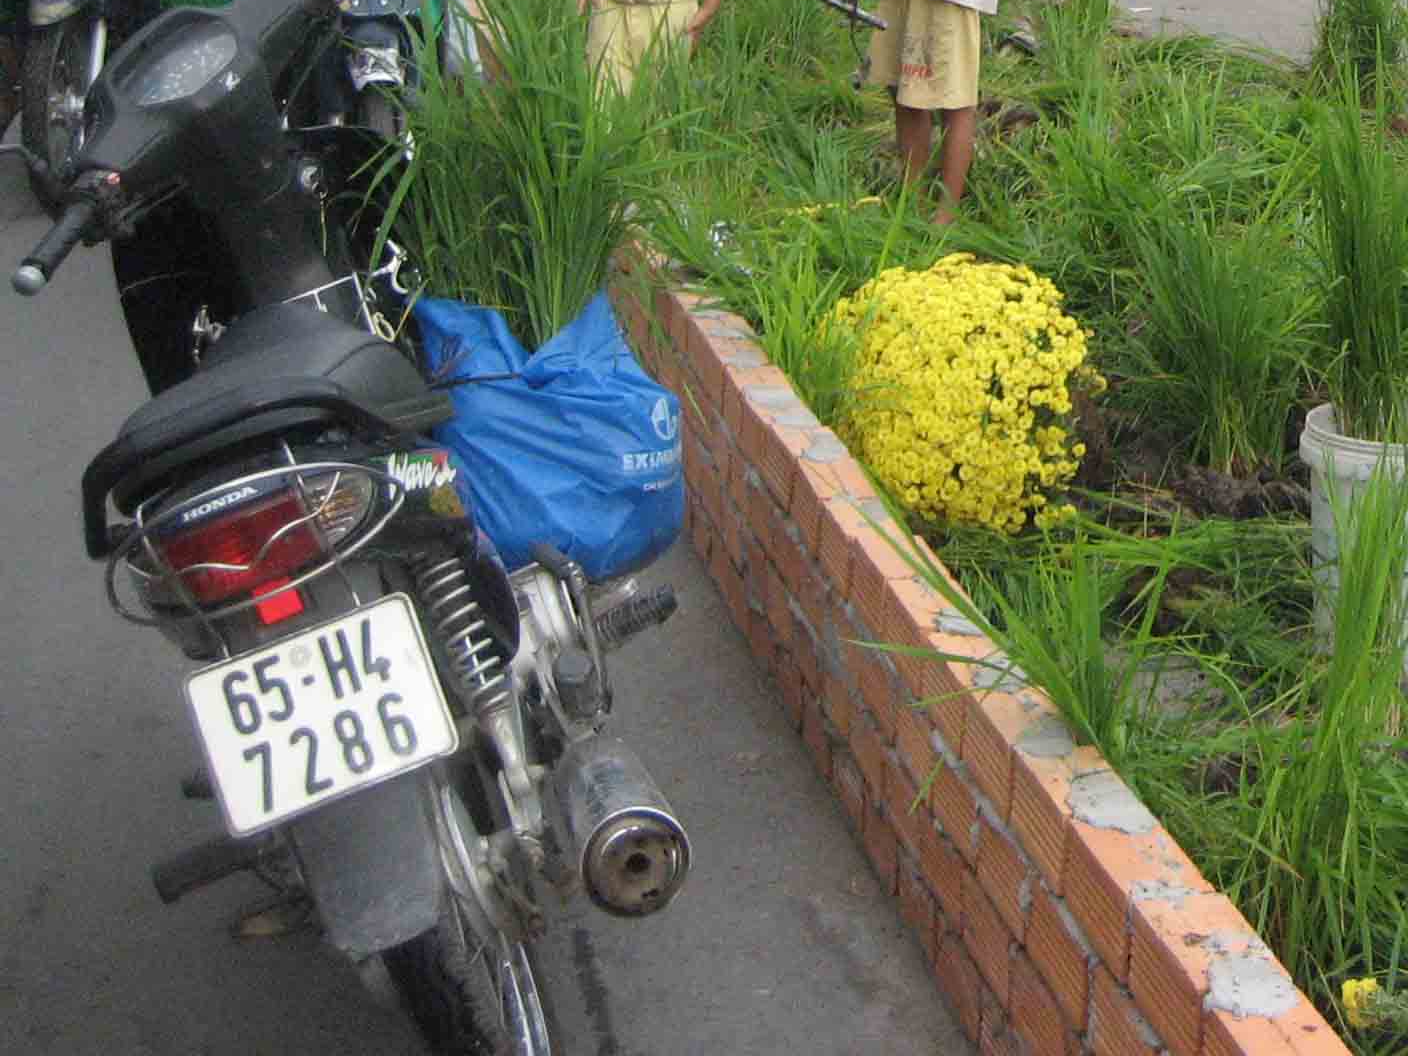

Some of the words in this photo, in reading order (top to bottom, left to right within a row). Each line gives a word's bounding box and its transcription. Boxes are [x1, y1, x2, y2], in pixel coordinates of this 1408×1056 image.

[183, 486, 259, 522] HONDA
[222, 618, 392, 735] 65-H4
[242, 692, 418, 813] 7286
